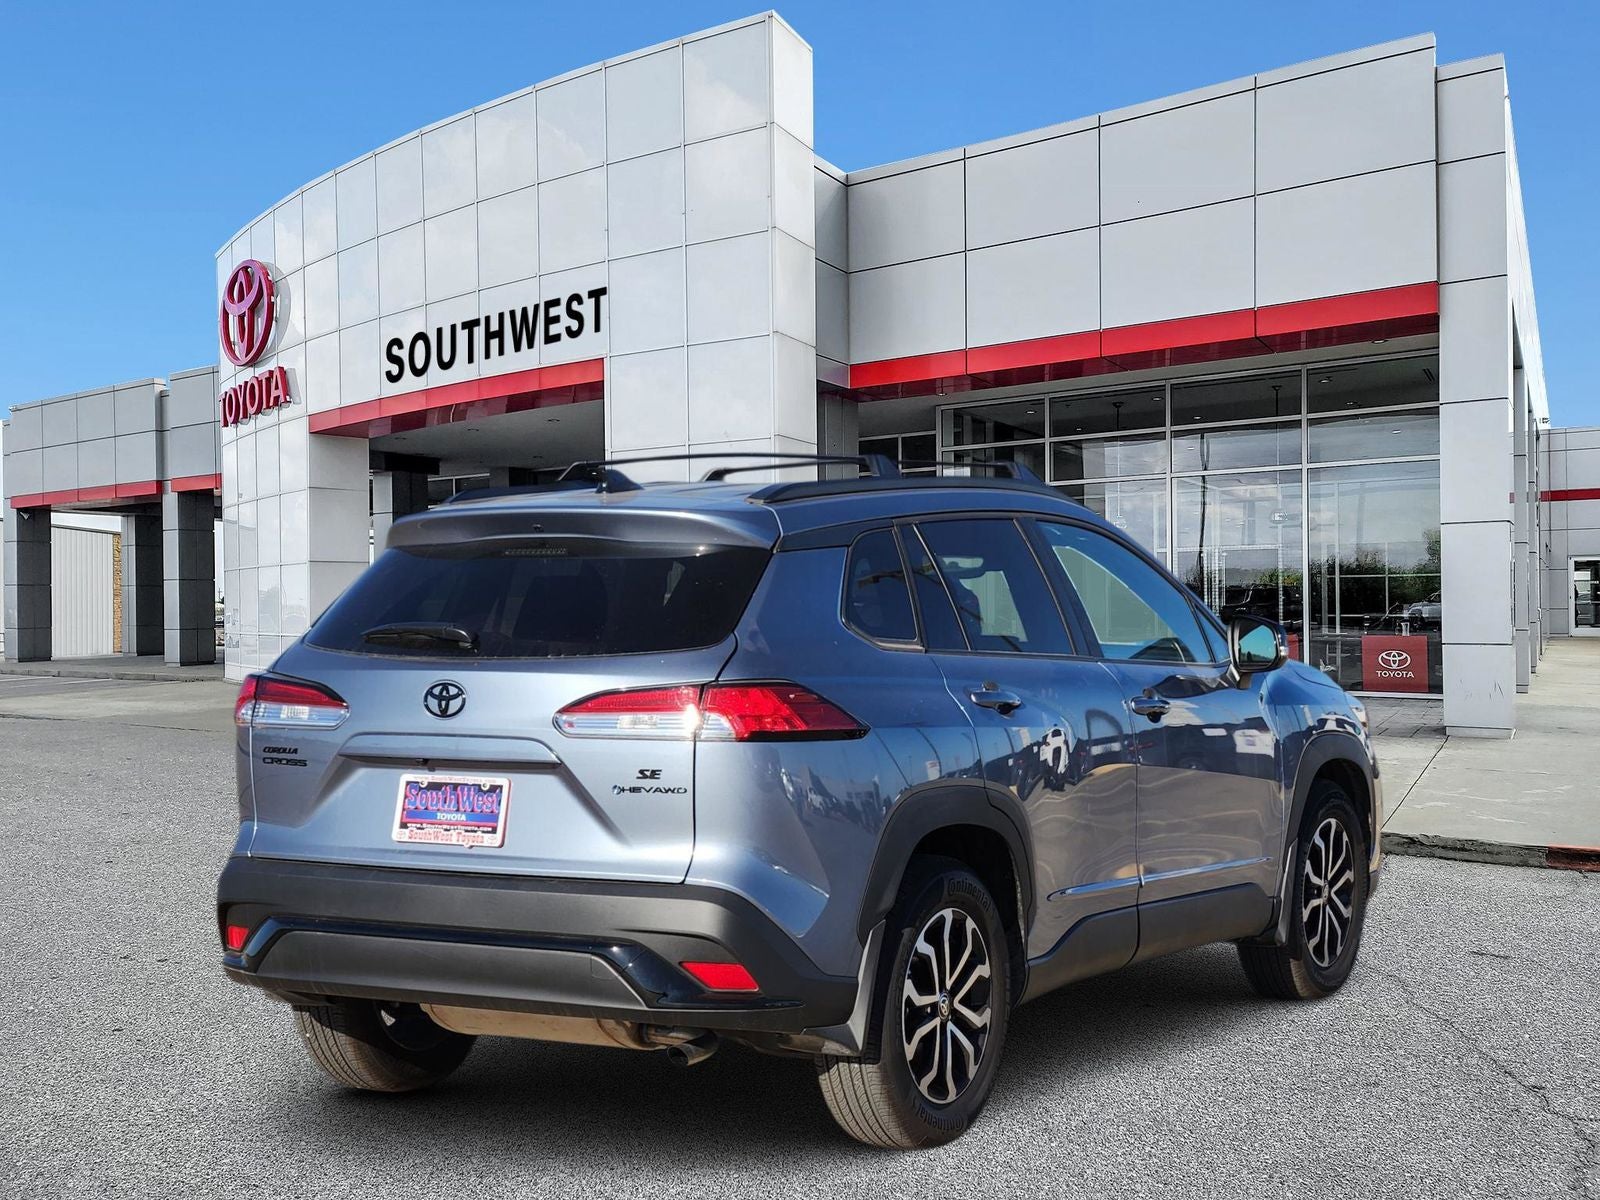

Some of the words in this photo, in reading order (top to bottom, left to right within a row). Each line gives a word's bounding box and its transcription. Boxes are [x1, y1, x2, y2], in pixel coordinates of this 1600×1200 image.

[385, 287, 608, 384] SOUTHWEST
[219, 366, 290, 428] TOYOTA
[1376, 670, 1415, 678] TOYOTA
[263, 746, 298, 755] COROLLA
[262, 757, 307, 767] CROSS
[636, 769, 662, 780] SE
[436, 812, 467, 821] TOYOTA
[456, 832, 485, 845] Toyota
[947, 878, 992, 912] Continental
